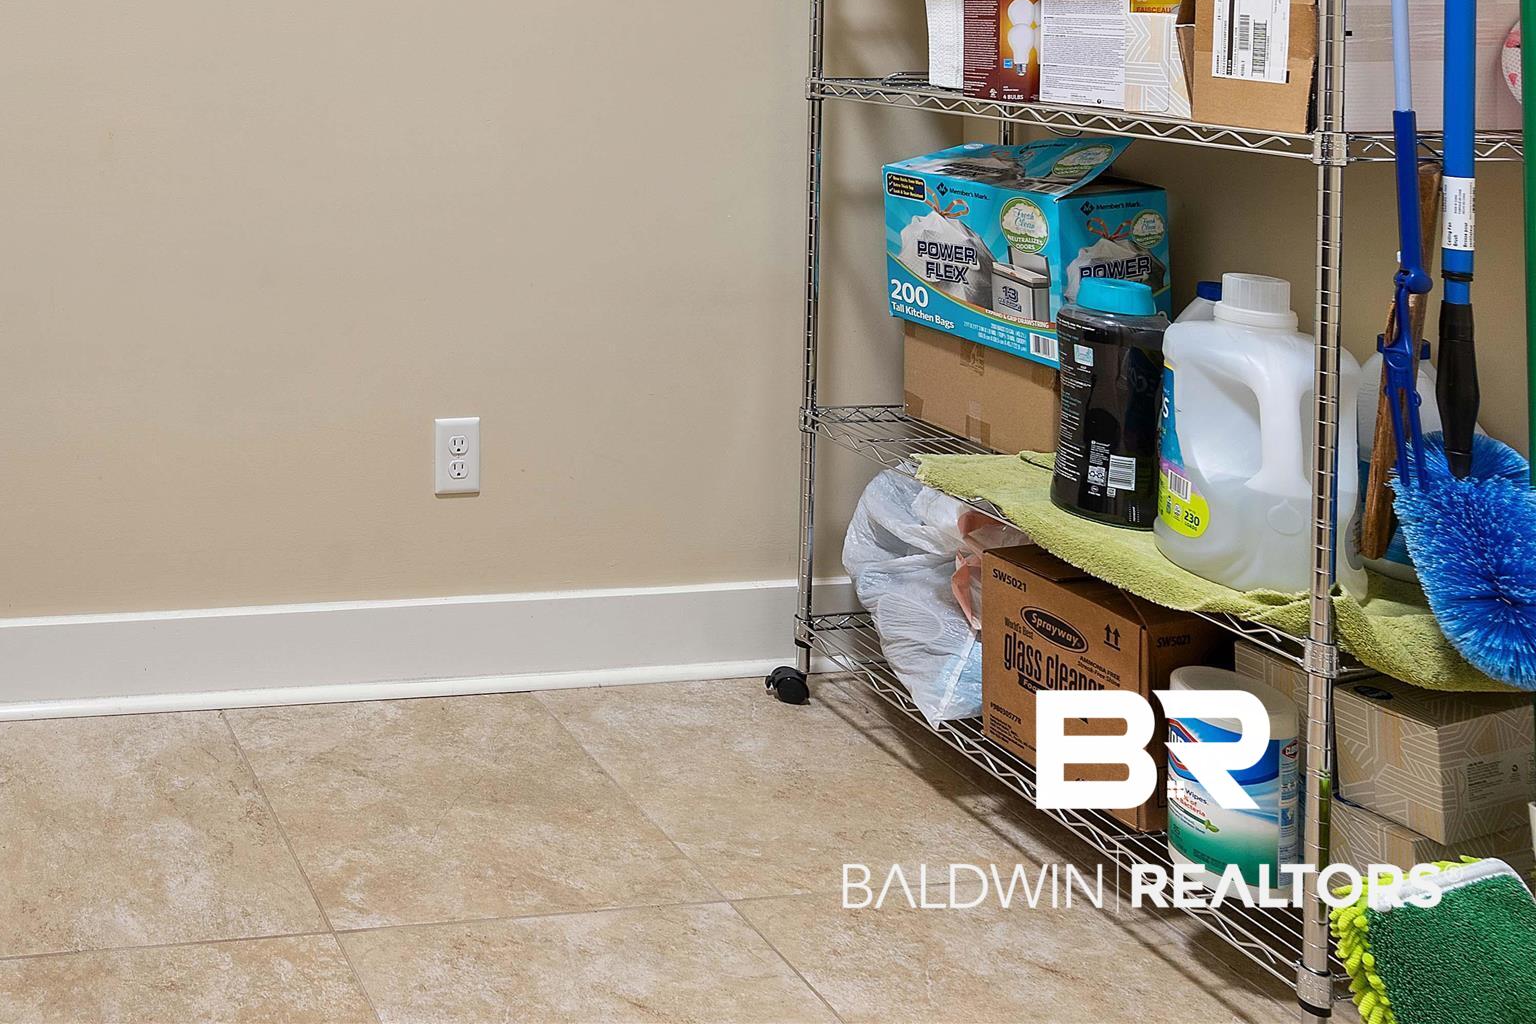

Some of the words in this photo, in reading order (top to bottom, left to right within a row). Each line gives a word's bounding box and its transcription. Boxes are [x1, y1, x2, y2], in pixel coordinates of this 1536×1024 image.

[949, 188, 974, 197] Member's
[1007, 234, 1044, 246] NEUTRALIZES
[917, 240, 978, 265] POWER
[925, 262, 970, 284] FLEX
[1080, 256, 1152, 278] POWER
[890, 279, 929, 308] 200
[1001, 286, 1019, 303] 13
[891, 302, 905, 313] Tall
[905, 305, 934, 323] Kitchen
[935, 314, 955, 330] Bags
[1184, 512, 1200, 526] 230
[992, 568, 1027, 592] SW5021
[1004, 617, 1022, 634] World's
[1022, 627, 1034, 640] Best
[1031, 613, 1079, 647] Sprayway
[1157, 635, 1191, 648] SW5021
[1004, 633, 1042, 682] glass
[1079, 656, 1106, 673] AMMONIA
[1106, 668, 1121, 682] FREE
[1077, 660, 1106, 682] Streak-Free
[1105, 675, 1121, 687] Shine
